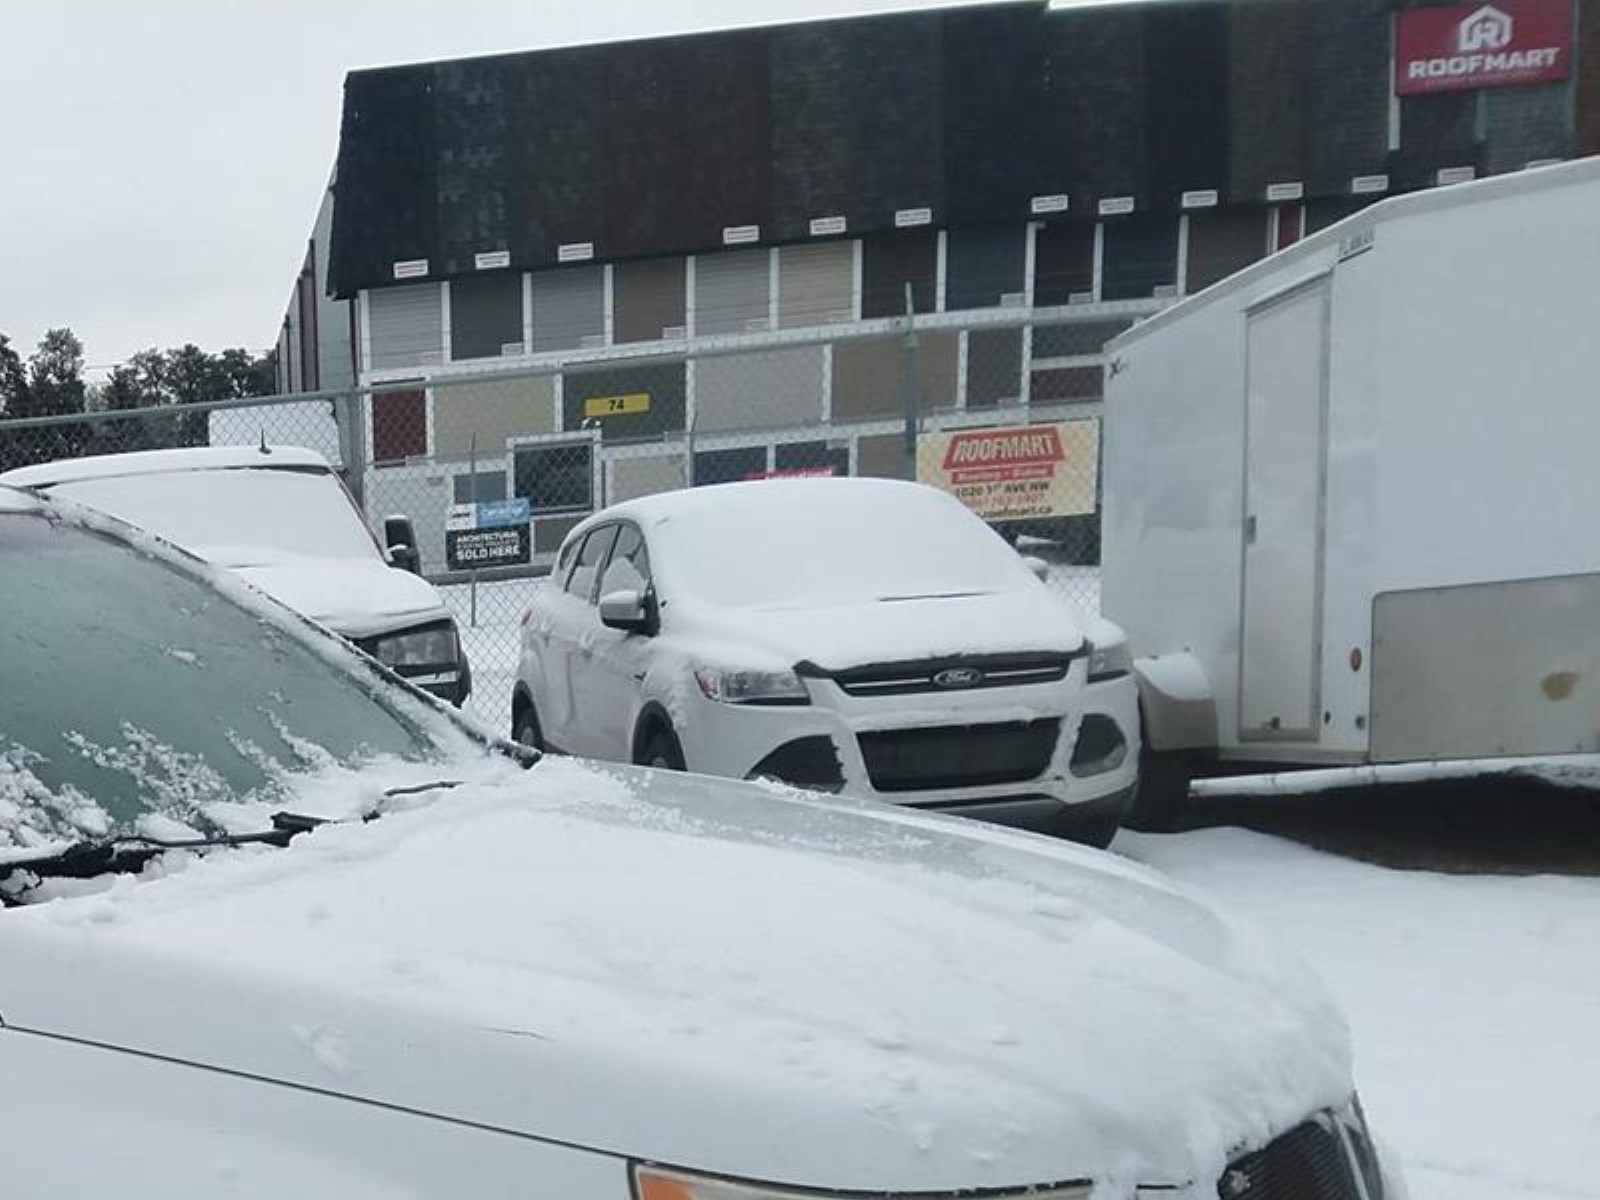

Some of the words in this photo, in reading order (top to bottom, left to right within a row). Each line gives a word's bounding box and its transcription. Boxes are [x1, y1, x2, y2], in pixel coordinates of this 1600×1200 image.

[1407, 47, 1561, 79] ROOFMART
[608, 399, 625, 412] 74
[952, 434, 1055, 463] ROOFMART
[457, 549, 488, 560] SOLD
[489, 545, 520, 558] HERE
